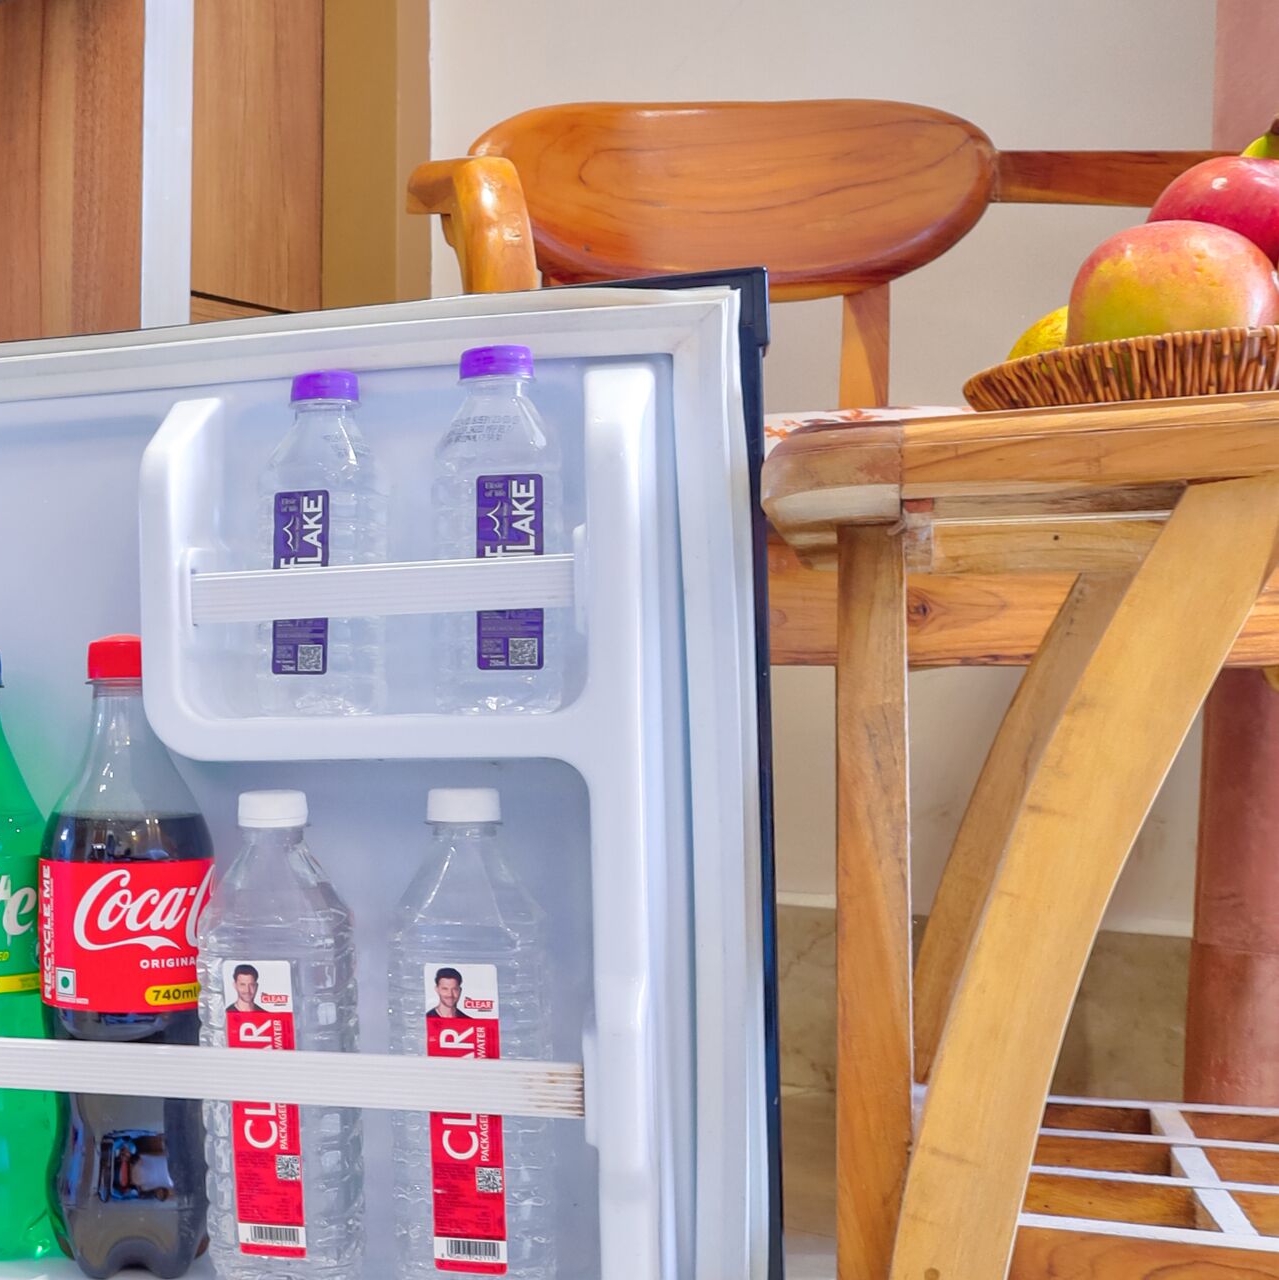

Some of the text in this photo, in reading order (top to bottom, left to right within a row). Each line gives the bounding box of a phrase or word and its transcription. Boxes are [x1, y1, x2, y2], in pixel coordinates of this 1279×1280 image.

[43, 865, 52, 1000] RECYCLE ME
[465, 1000, 492, 1009] CLEAR
